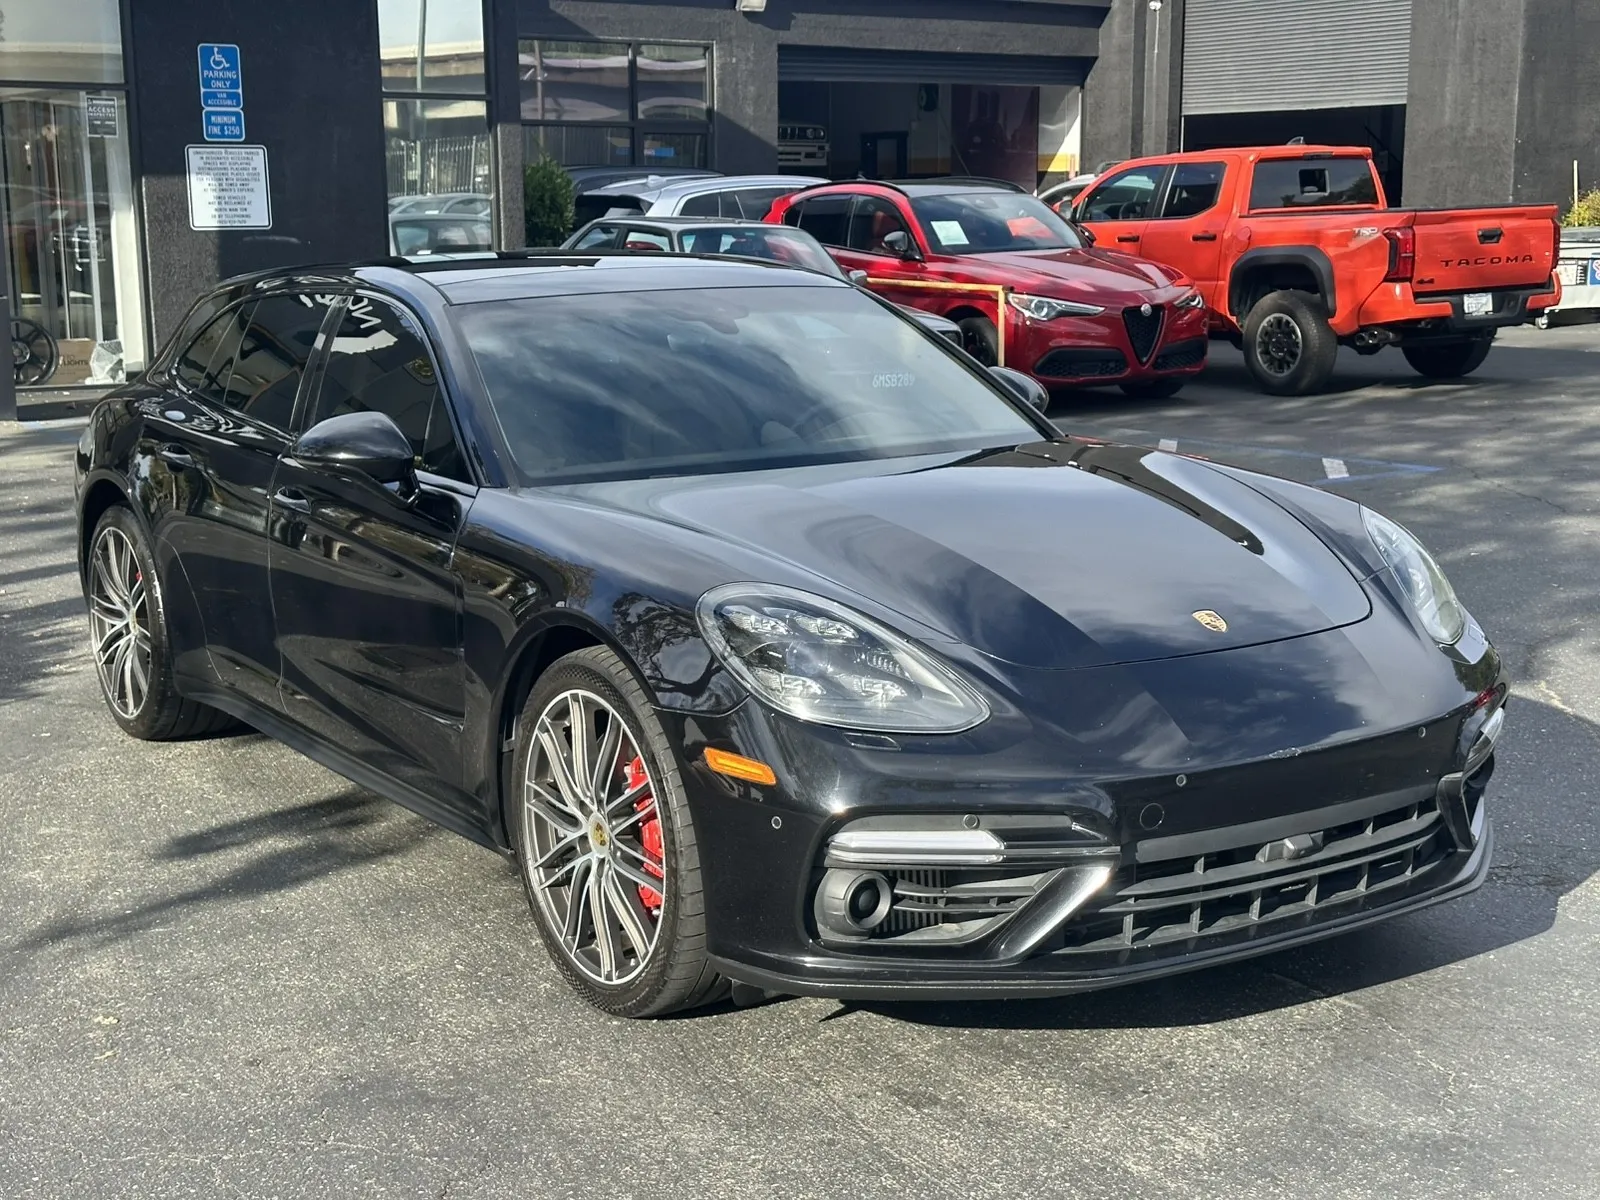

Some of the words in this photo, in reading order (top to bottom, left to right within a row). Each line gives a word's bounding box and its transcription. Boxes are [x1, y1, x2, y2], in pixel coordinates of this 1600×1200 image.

[203, 70, 237, 79] PARKING
[211, 80, 231, 88] ONLY
[210, 116, 236, 124] MINIMUM
[208, 126, 222, 134] FINE
[224, 126, 240, 136] $250
[1440, 254, 1533, 268] TACOMA
